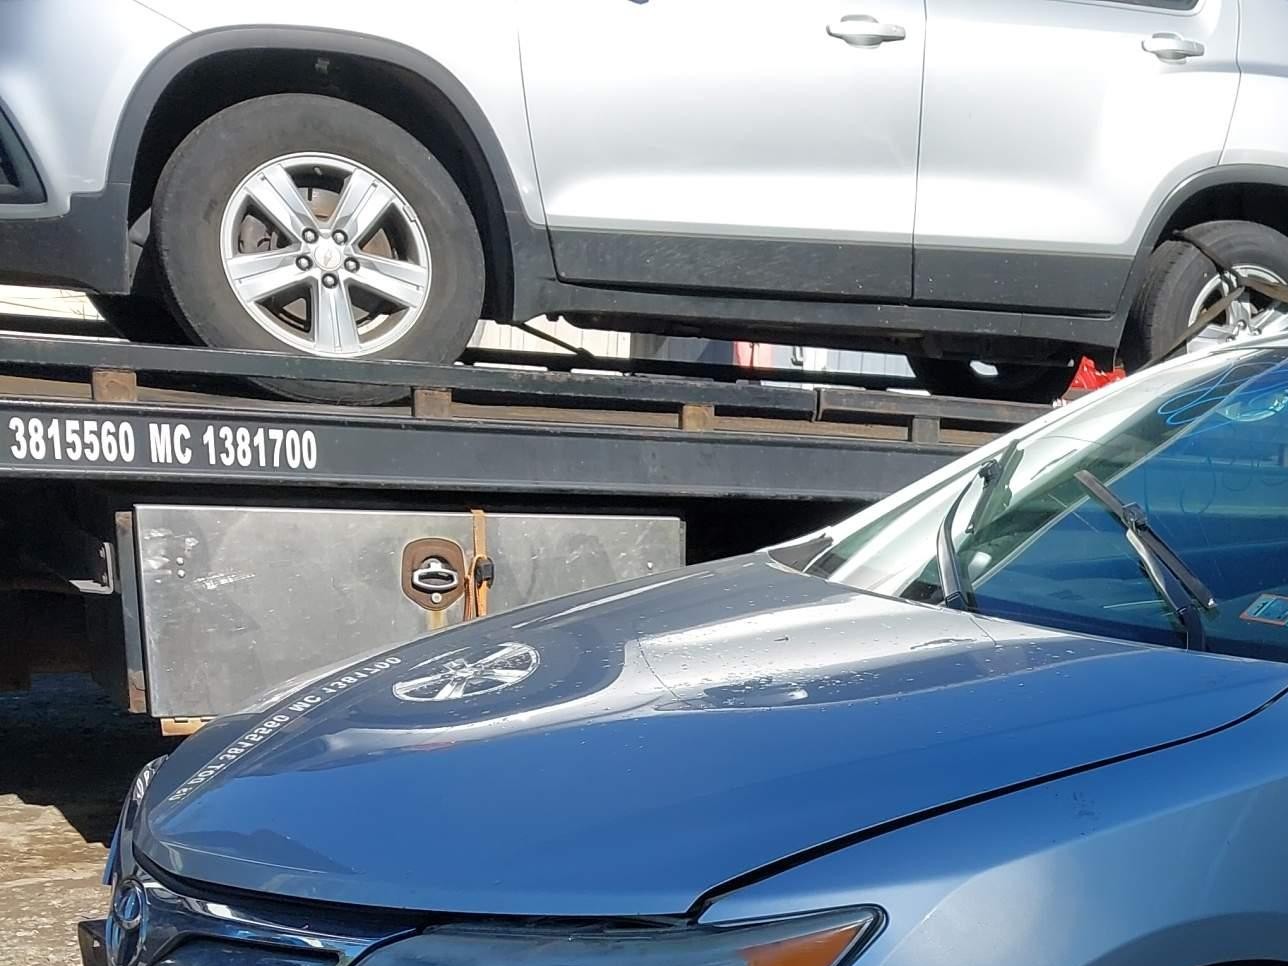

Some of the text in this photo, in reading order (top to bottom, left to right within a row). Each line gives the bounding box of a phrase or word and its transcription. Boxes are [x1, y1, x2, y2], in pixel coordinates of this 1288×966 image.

[8, 416, 317, 469] 3815560 MC 1381700
